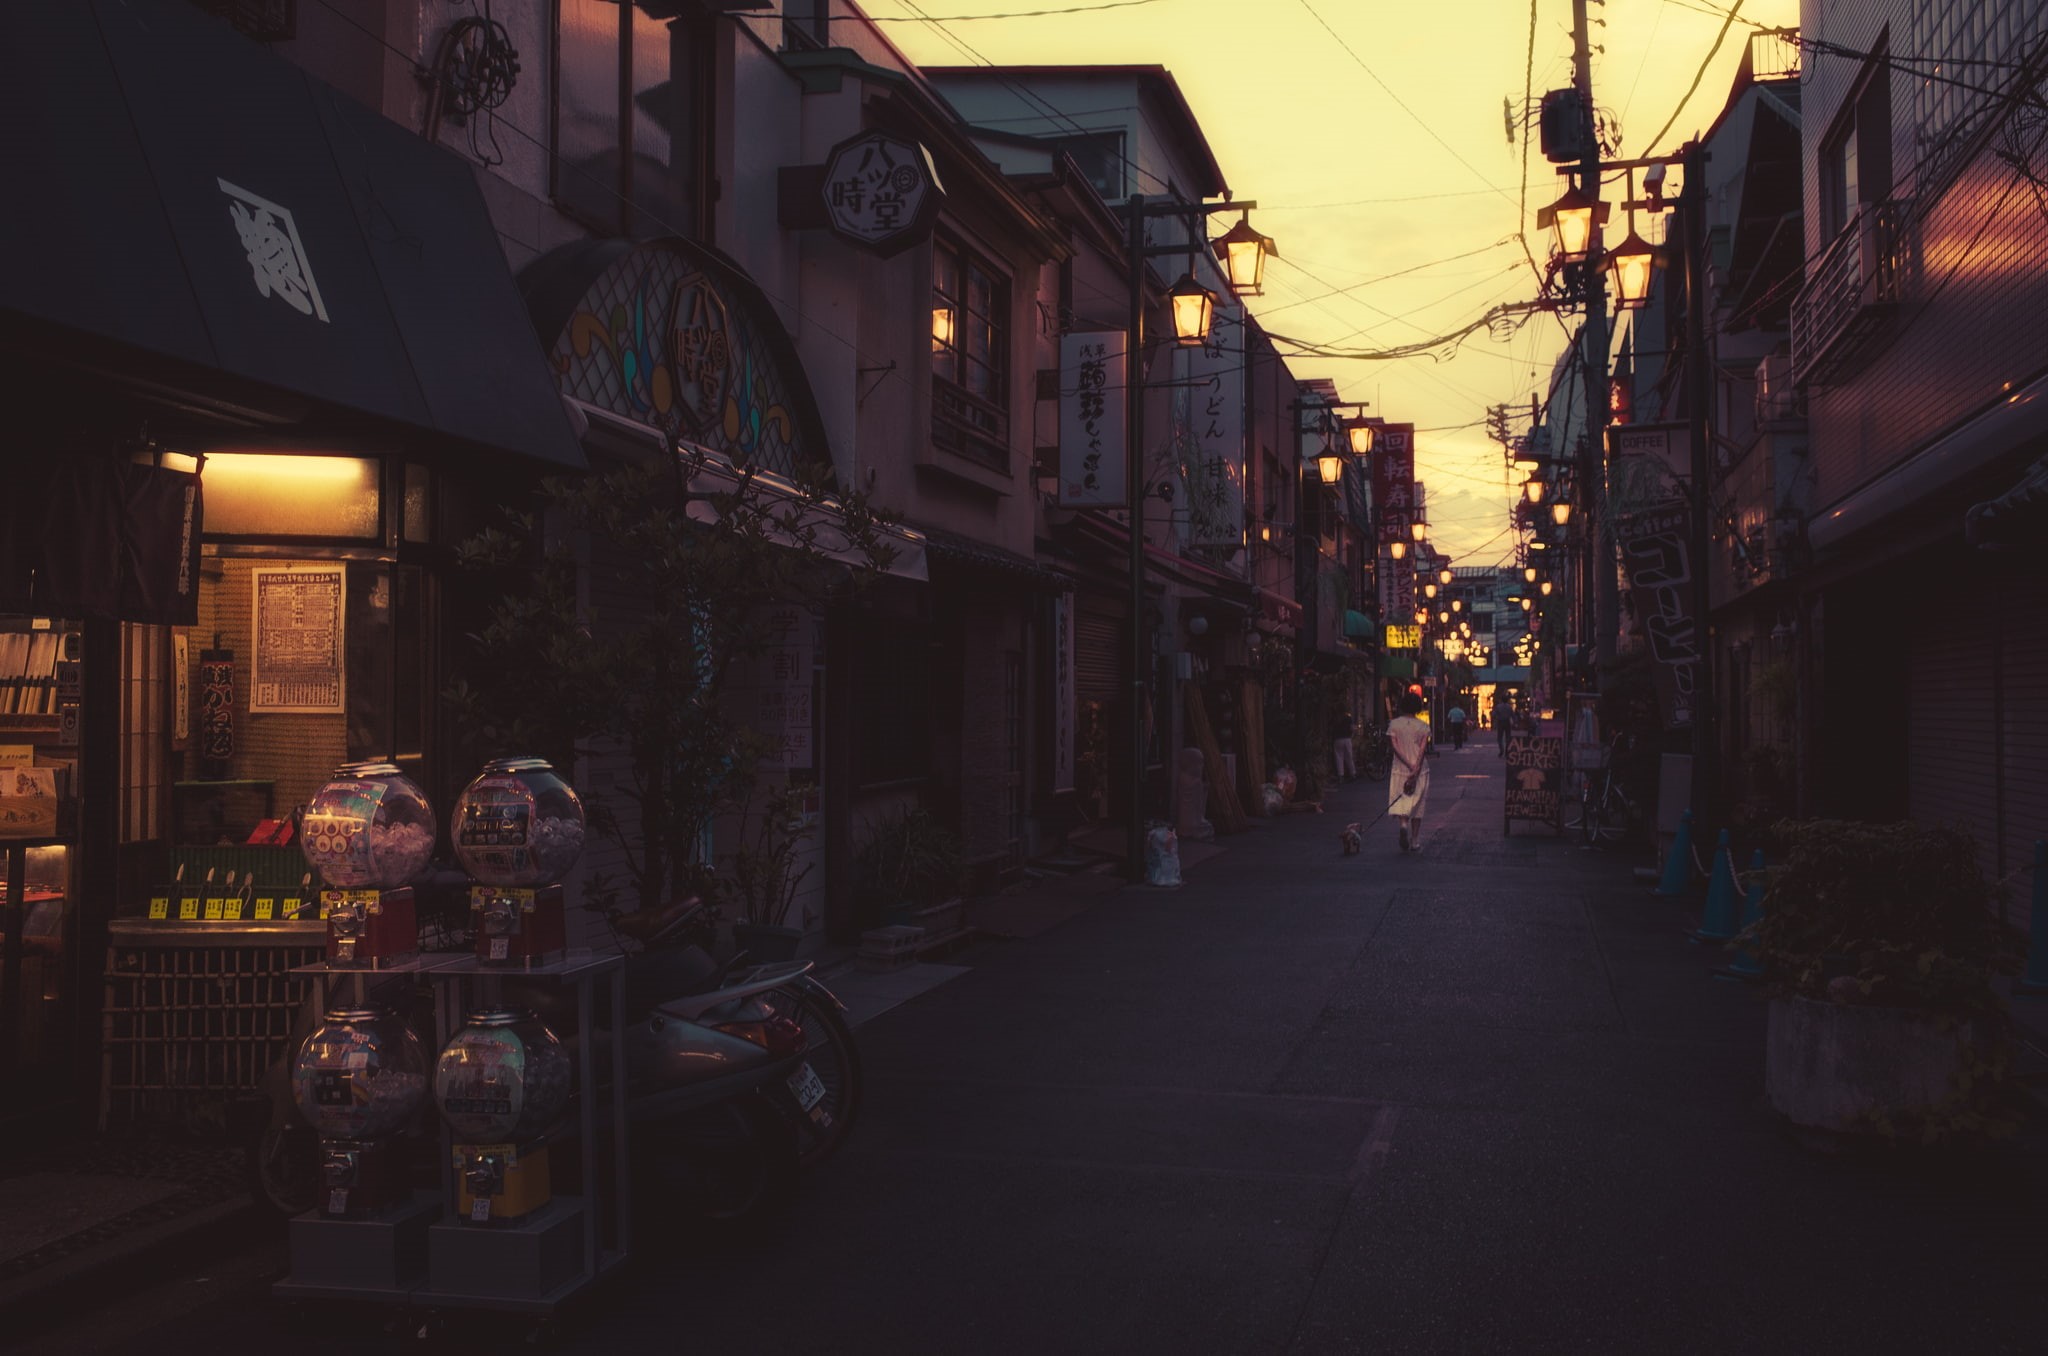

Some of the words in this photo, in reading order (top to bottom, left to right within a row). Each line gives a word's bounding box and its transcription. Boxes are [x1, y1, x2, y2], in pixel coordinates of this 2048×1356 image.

[1205, 373, 1224, 439] うどん
[1622, 436, 1664, 449] COFFEE
[1384, 432, 1409, 540] 回転寿司
[1507, 736, 1560, 755] ALOHA
[1507, 752, 1559, 769] SHIRTS
